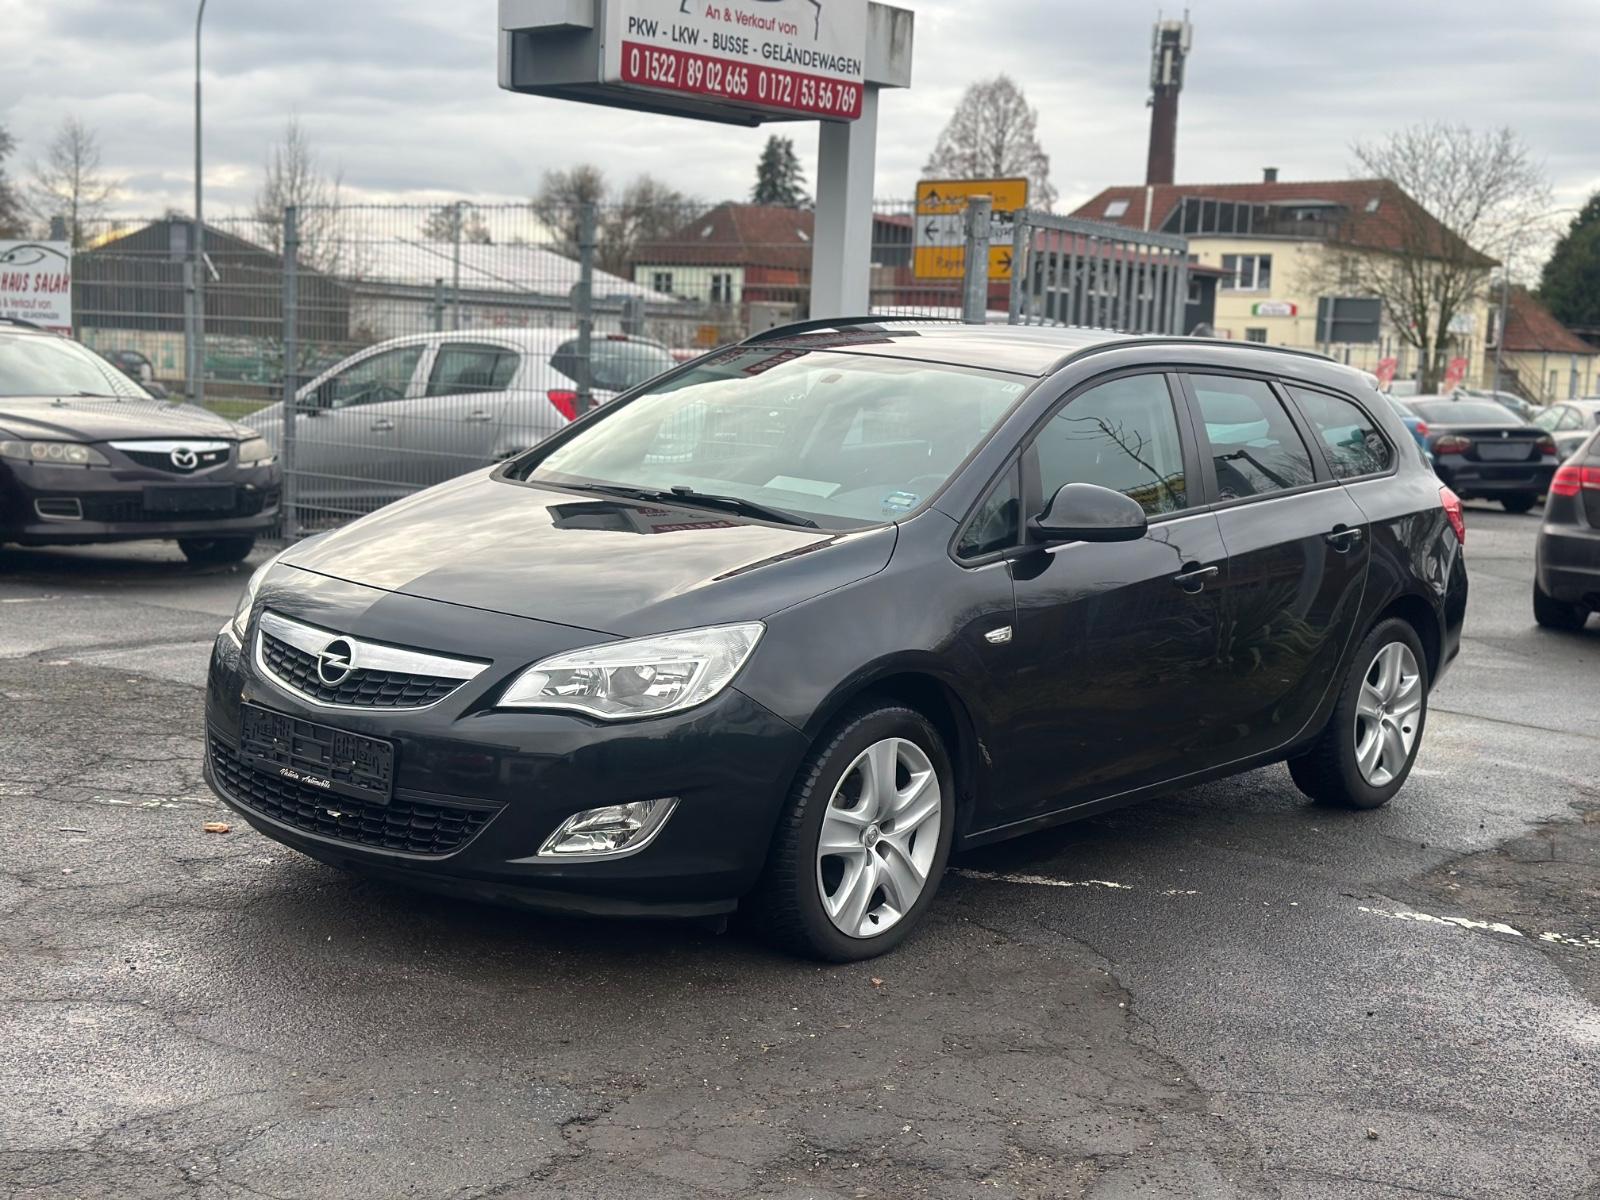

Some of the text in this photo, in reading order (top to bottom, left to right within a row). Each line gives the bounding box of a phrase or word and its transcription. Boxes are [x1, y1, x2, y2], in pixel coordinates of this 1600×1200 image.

[628, 16, 659, 38] PKW
[671, 24, 700, 45] LKW
[712, 32, 749, 55] BUSSE
[761, 42, 861, 76] GELÄNDEWAGEN
[705, 4, 797, 36] An & Verkauf von
[630, 48, 640, 78] 0
[645, 50, 676, 83] 1522
[687, 58, 703, 87] 89
[706, 61, 722, 91] 02
[725, 65, 748, 96] 665
[758, 71, 767, 98] 0
[771, 73, 792, 103] 172
[801, 79, 816, 106] 53
[818, 82, 833, 109] 56
[835, 85, 857, 112] 769
